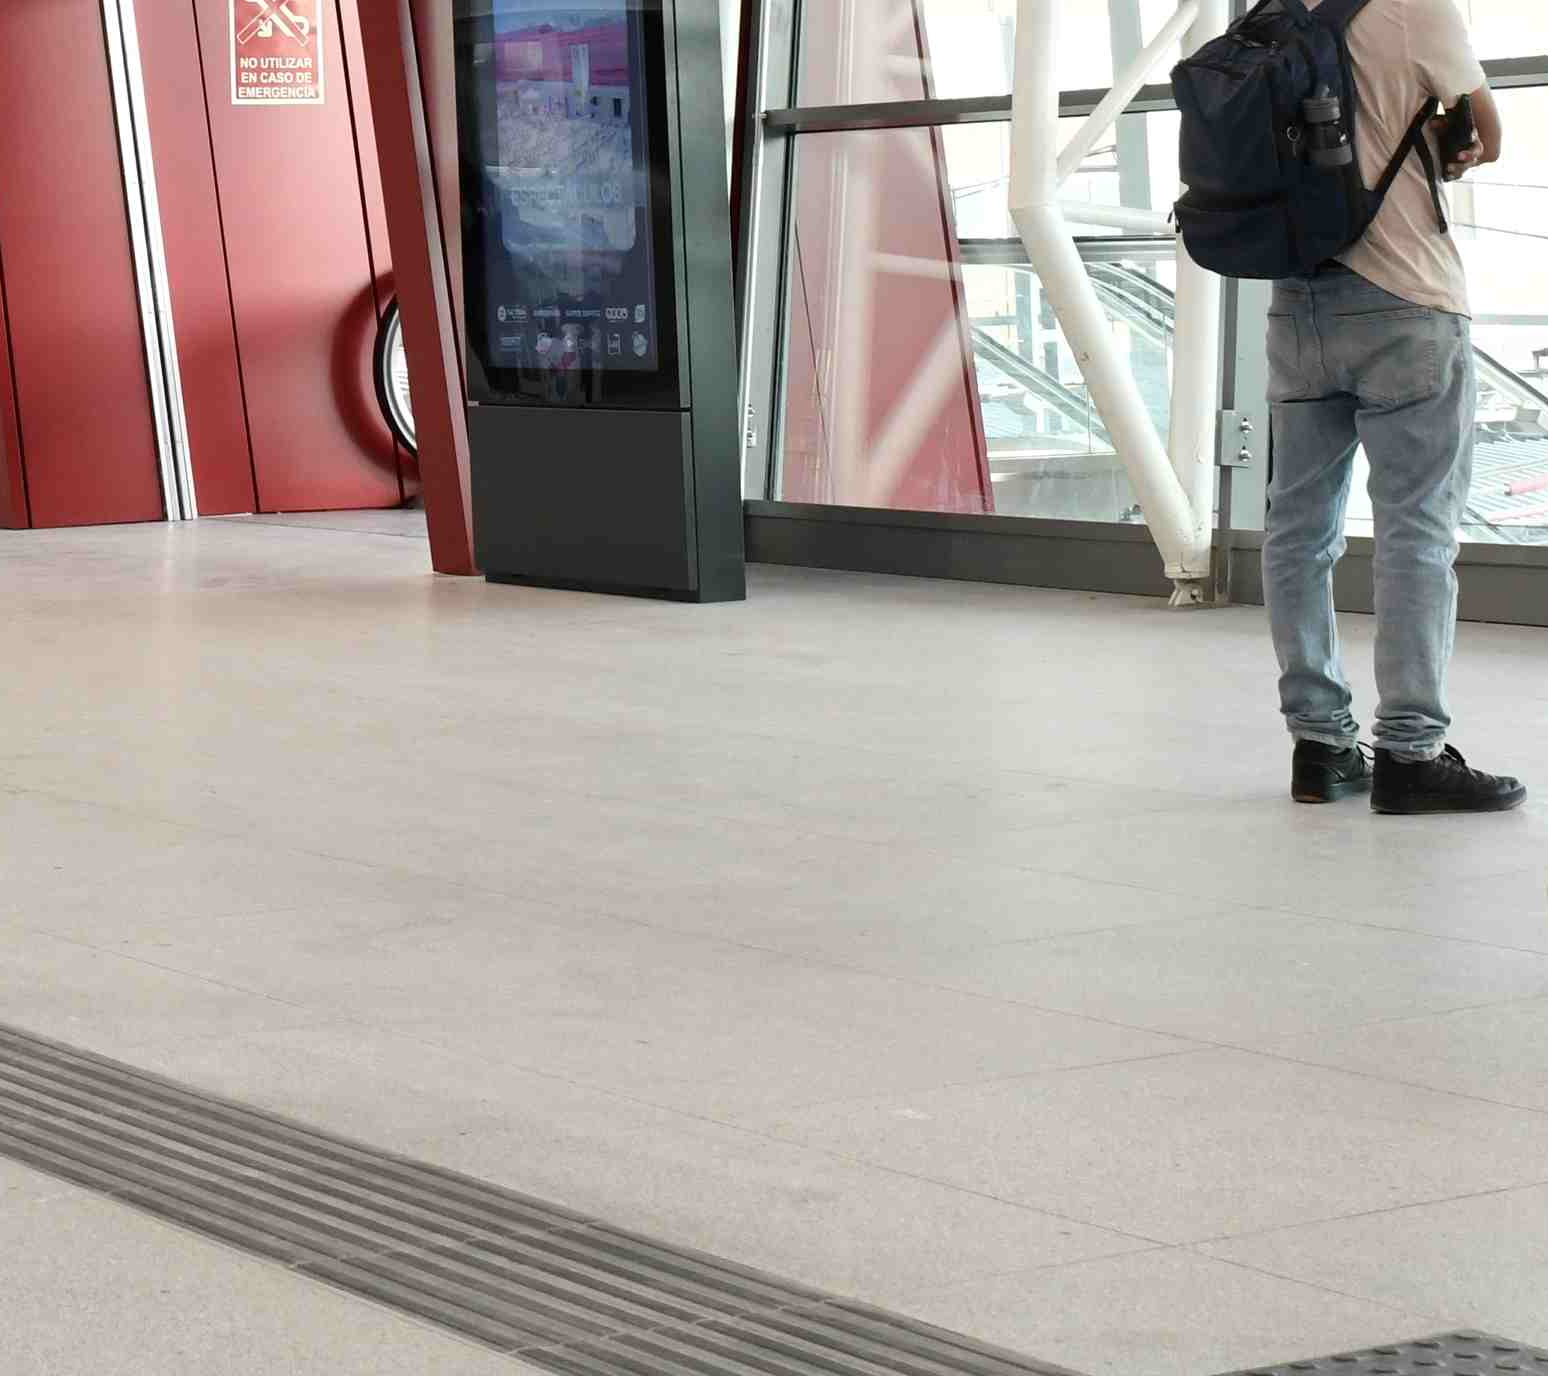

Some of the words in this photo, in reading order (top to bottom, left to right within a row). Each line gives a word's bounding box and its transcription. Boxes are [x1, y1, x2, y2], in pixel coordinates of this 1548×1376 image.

[239, 57, 258, 69] NO
[260, 57, 313, 69] UTILIZAR
[240, 72, 257, 84] EN
[260, 72, 293, 84] CASO
[295, 72, 313, 84] DE
[238, 86, 316, 98] EMERGENCIA
